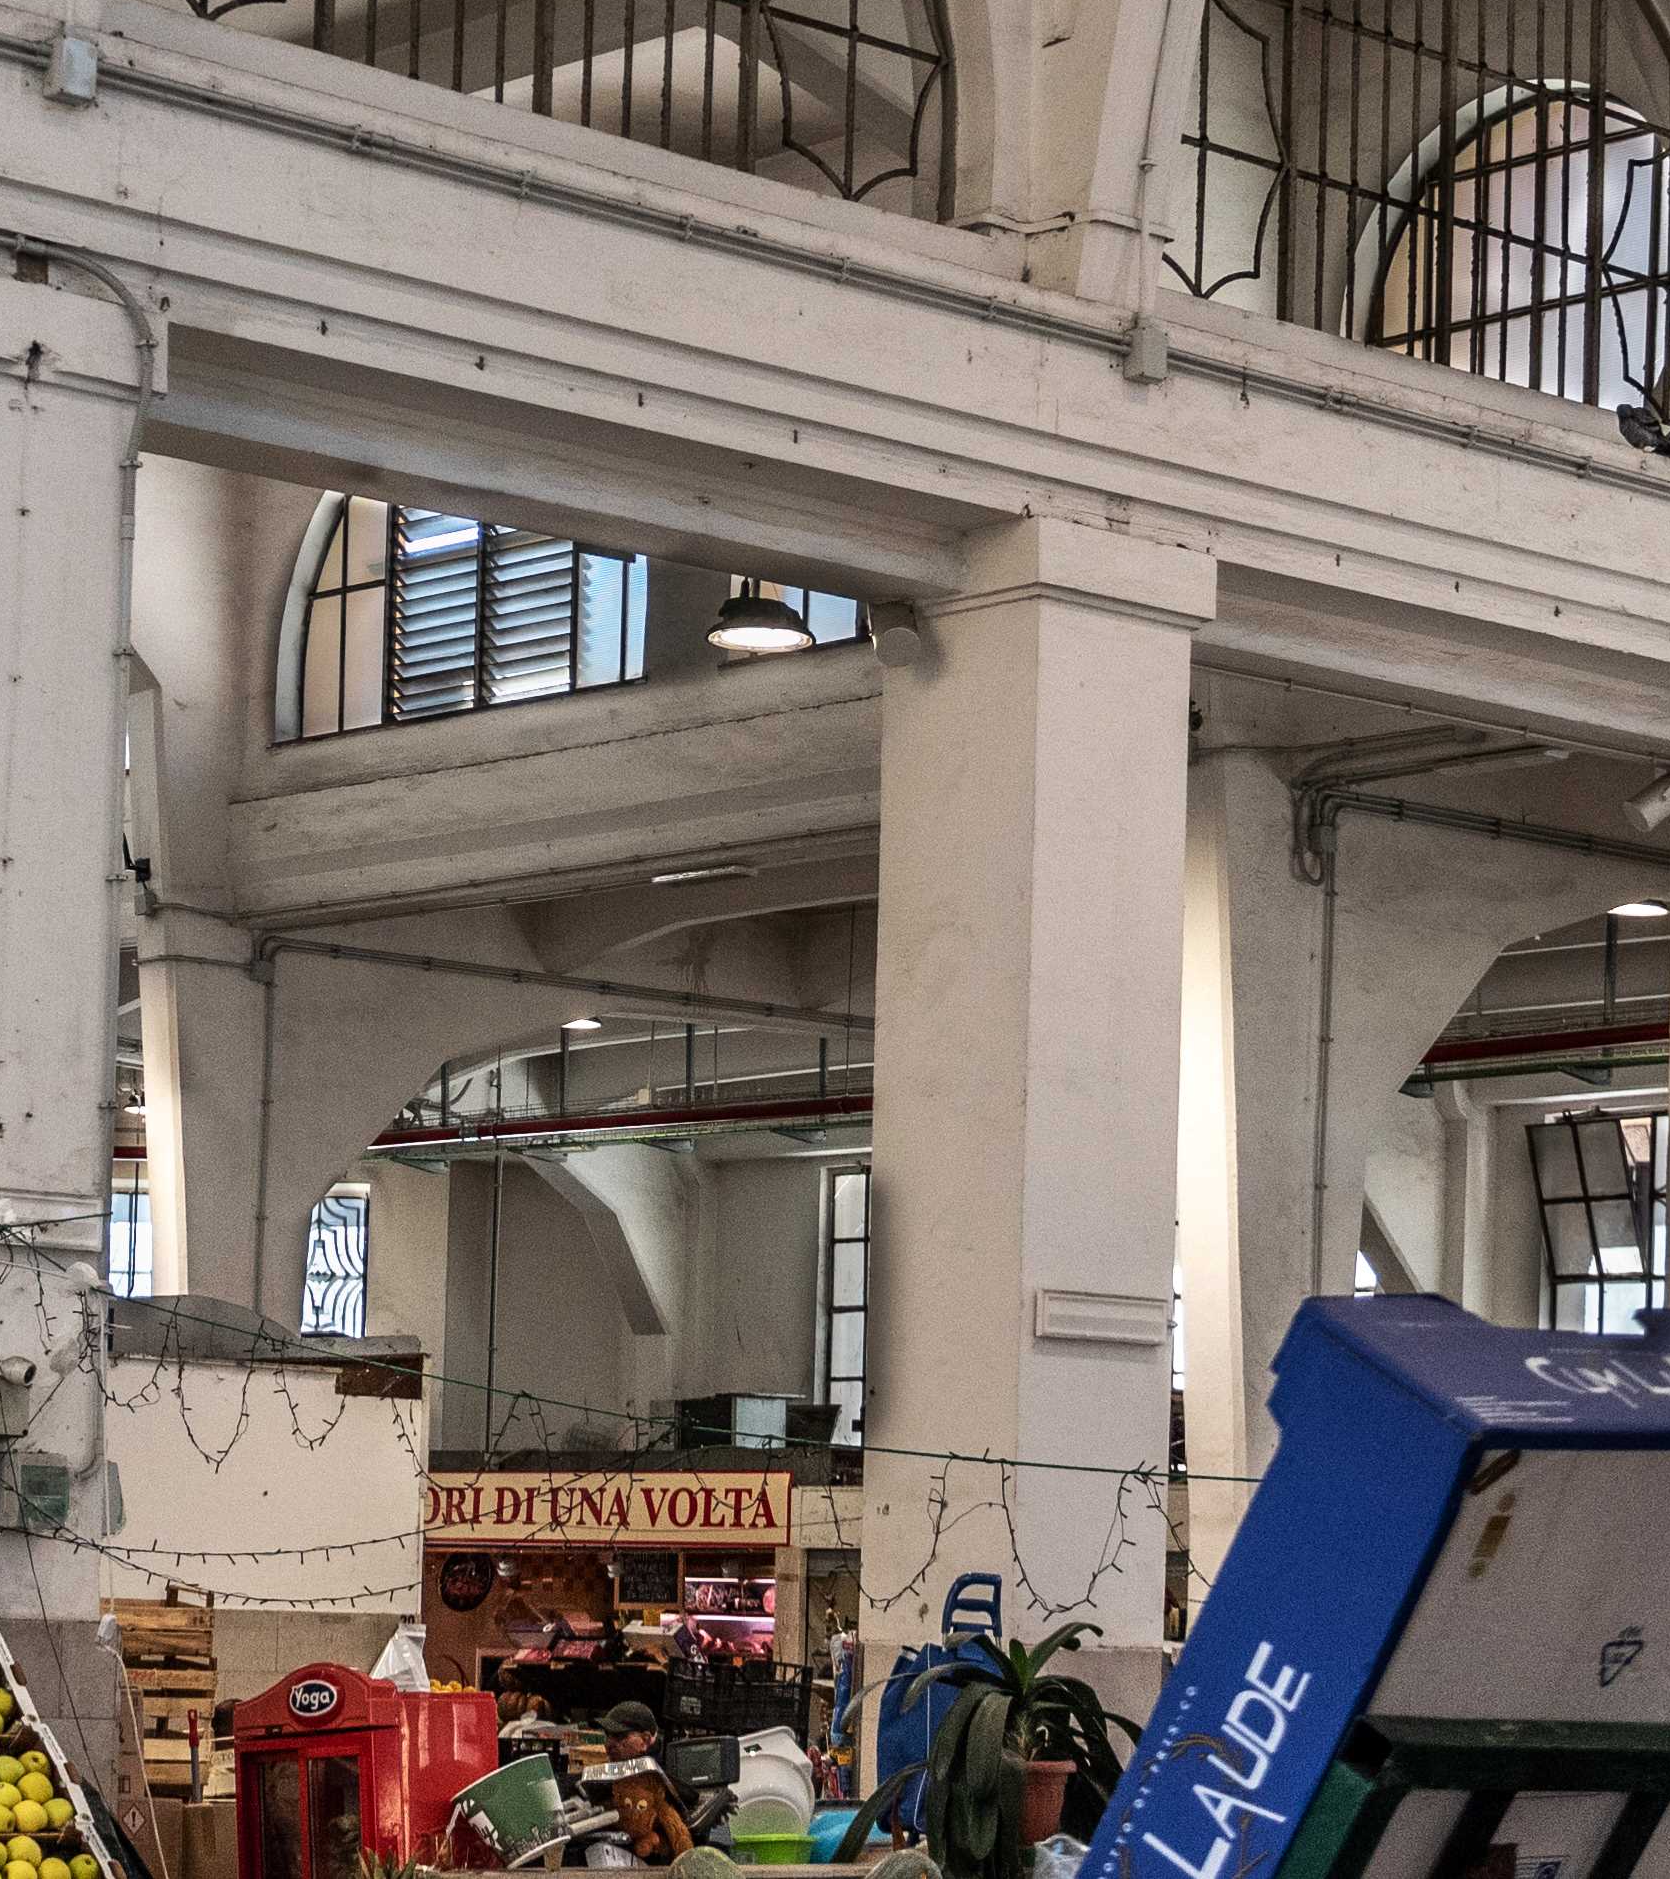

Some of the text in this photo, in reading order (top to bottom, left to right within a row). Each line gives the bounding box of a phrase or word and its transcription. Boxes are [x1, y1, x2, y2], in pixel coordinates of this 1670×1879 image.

[495, 1487, 539, 1525] DI
[550, 1487, 629, 1527] UNA
[640, 1487, 778, 1528] VOLTA
[294, 1686, 331, 1710] Yoga
[1142, 1641, 1312, 1879] LAUDE
